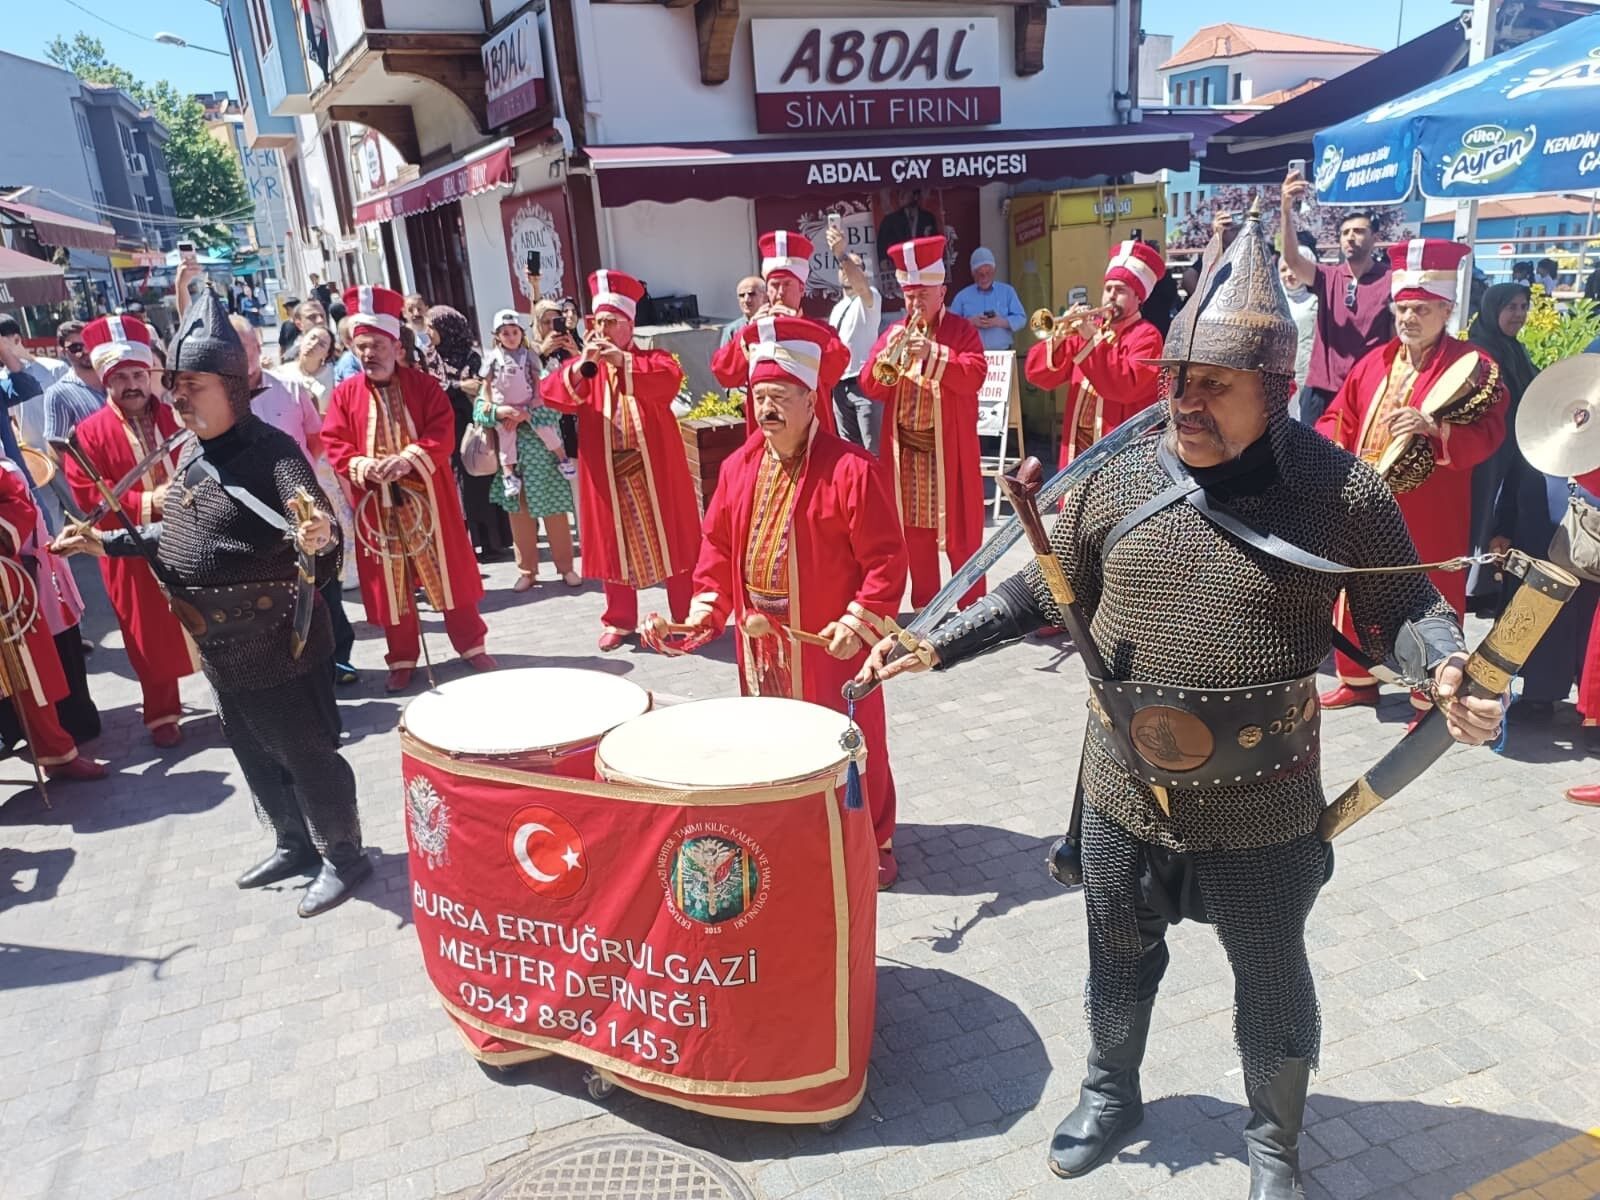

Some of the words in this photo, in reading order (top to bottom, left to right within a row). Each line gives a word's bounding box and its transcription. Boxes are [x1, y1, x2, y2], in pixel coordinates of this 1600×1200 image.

[779, 28, 973, 84] ABDAL
[786, 93, 876, 128] SİMİT
[889, 97, 979, 124] FIRINI
[807, 161, 881, 185] ABDAL
[891, 158, 931, 183] ÇAY
[1451, 137, 1524, 181] Ayran
[730, 827, 762, 856] KALKAN
[761, 866, 772, 891] HALK
[733, 892, 768, 930] OYUNLARI
[414, 879, 490, 936] BURSA
[496, 914, 757, 987] ERTUĞRULGAZİ
[704, 926, 722, 935] 2015
[439, 934, 556, 992] MEHTER
[565, 969, 708, 1029] DERNEĞİ
[459, 982, 529, 1024] 0543
[538, 1004, 597, 1037] 886
[608, 1020, 680, 1065] 1453
